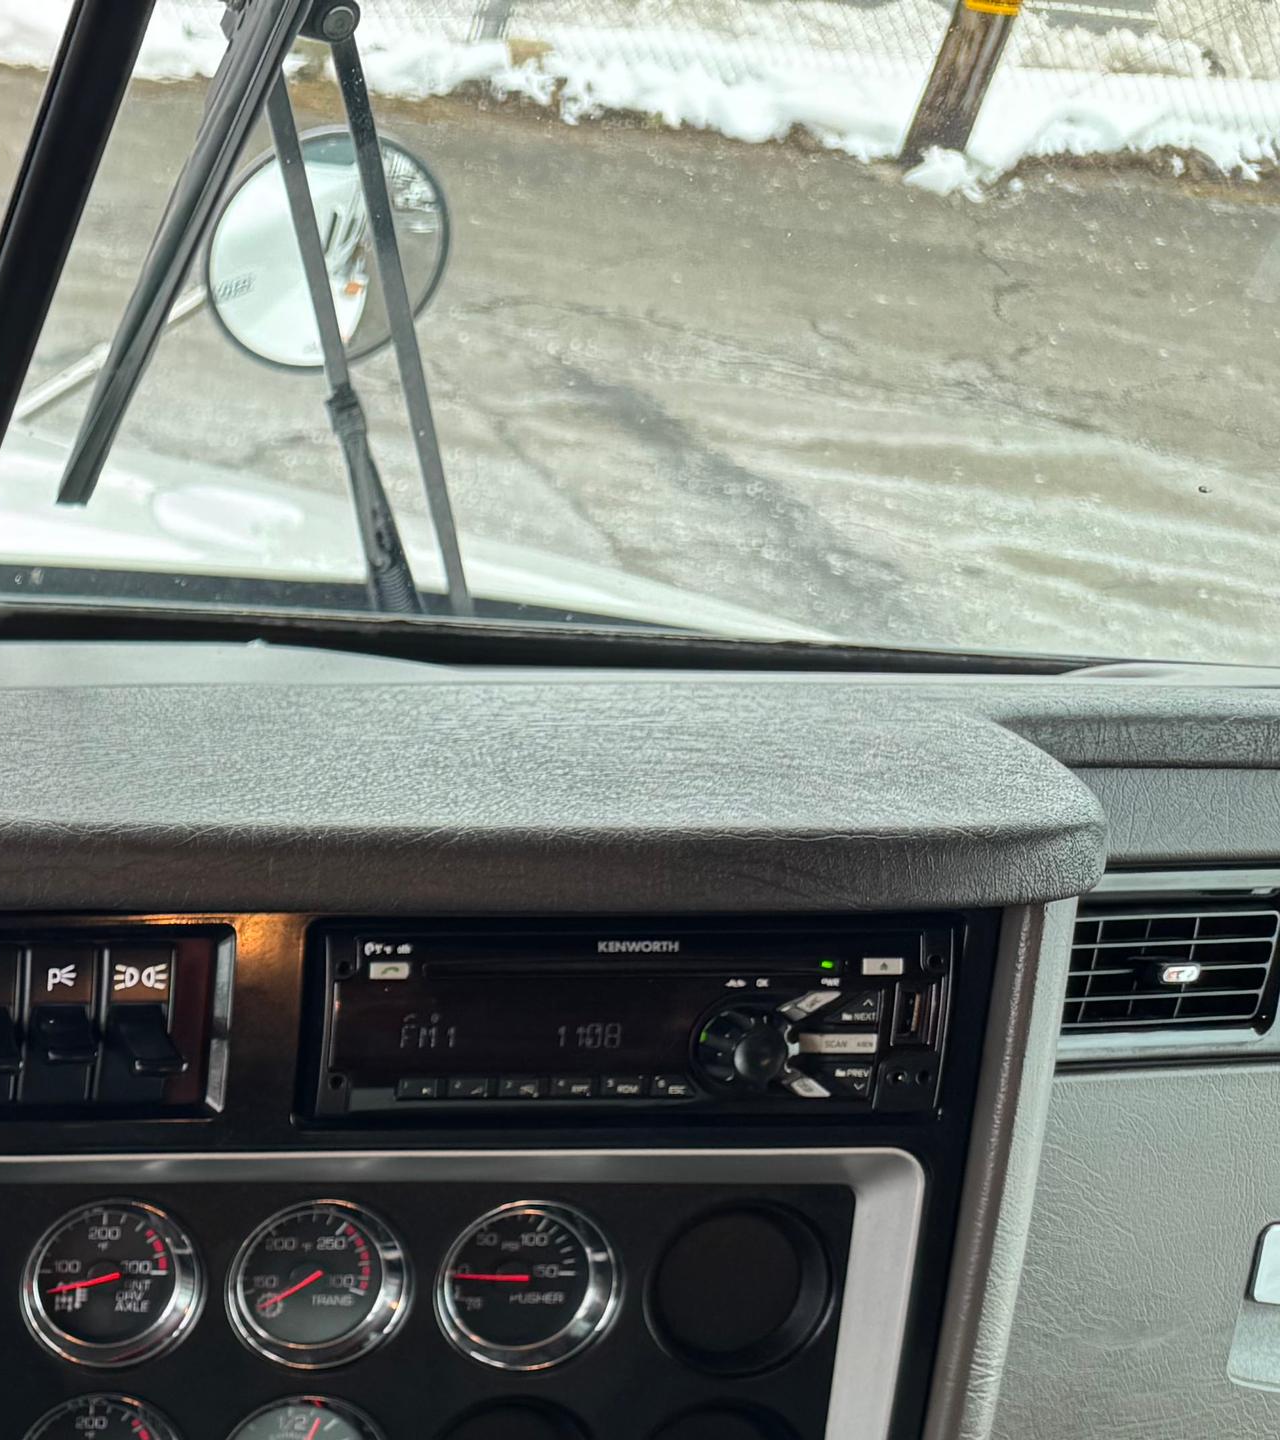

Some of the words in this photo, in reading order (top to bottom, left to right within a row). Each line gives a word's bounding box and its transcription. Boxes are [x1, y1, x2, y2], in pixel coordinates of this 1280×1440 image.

[597, 941, 680, 952] KENWORTH
[853, 1012, 876, 1021] NEXT
[846, 1068, 869, 1078] PREV
[88, 1226, 121, 1241] 200
[476, 1233, 498, 1247] 50
[520, 1232, 549, 1247] 100
[316, 1236, 347, 1250] 250
[54, 1260, 81, 1274] 100
[114, 1301, 150, 1313] AXLE
[74, 1416, 108, 1430] 200
